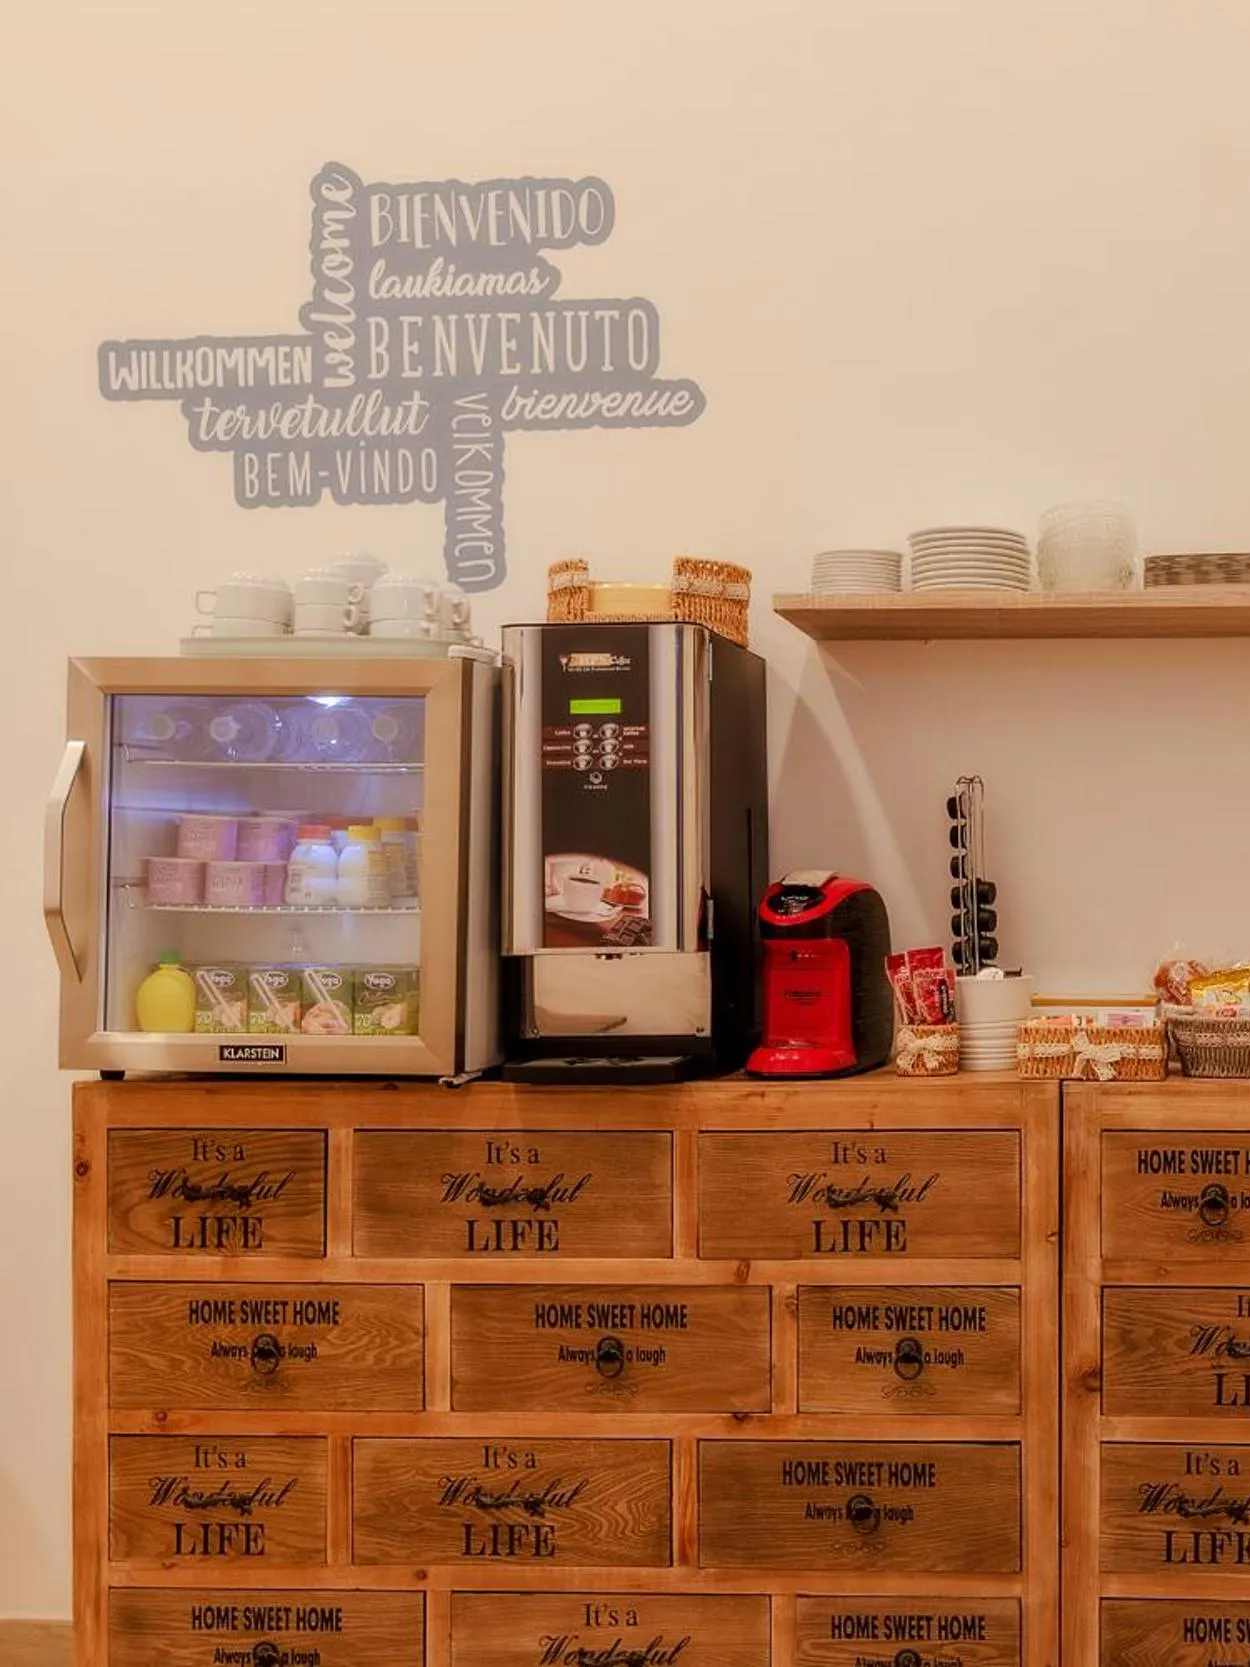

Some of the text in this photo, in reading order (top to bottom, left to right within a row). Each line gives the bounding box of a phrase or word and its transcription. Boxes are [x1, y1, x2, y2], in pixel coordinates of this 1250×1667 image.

[369, 187, 605, 249] BIENVENIDO
[321, 172, 357, 388] welcome
[368, 256, 551, 300] laukiamas
[367, 308, 652, 380] BENVENUTO
[108, 345, 313, 391] WILLKOMMEN
[193, 389, 430, 442] tervetullut
[501, 386, 695, 420] bienvenue
[223, 1047, 280, 1059] KLARSTEIN
[192, 1138, 245, 1161] It's a
[486, 1141, 540, 1164] It's a
[832, 1141, 887, 1164] It's a
[1137, 1150, 1186, 1175] HOME
[1190, 1150, 1240, 1175] SWEET
[148, 1169, 296, 1204] Wodful
[440, 1172, 592, 1205] Wodful
[786, 1172, 941, 1205] Wodful
[1160, 1190, 1199, 1210] Always
[170, 1216, 263, 1249] LIFE
[466, 1220, 559, 1252] LIFE
[812, 1220, 907, 1253] LIFE
[189, 1301, 340, 1326] HOME SWEET HOME
[535, 1304, 688, 1329] HOME SWEET HOME
[832, 1306, 986, 1332] HOME SWEET HOME
[211, 1341, 249, 1362] Always
[288, 1341, 318, 1362] laugh
[557, 1345, 595, 1365] Always
[636, 1345, 667, 1366] laugh
[855, 1347, 893, 1368] Always
[934, 1347, 965, 1368] laugh
[194, 1446, 247, 1469] It's a
[483, 1446, 537, 1469] It's a
[1184, 1451, 1240, 1476] It's a
[782, 1462, 936, 1487] HOME SWEET HOME
[148, 1475, 298, 1509] Wodful
[436, 1475, 590, 1510] Wodful
[804, 1502, 844, 1523] Always
[884, 1503, 915, 1524] laugh
[173, 1523, 265, 1556] LIFE
[461, 1523, 556, 1557] LIFE
[192, 1606, 342, 1632] HOME SWEET HOME
[585, 1604, 638, 1627] It's a
[831, 1615, 986, 1640] HOME SWEET HOME
[1184, 1619, 1231, 1644] HOME
[214, 1647, 251, 1667] Always
[291, 1647, 321, 1667] laugh
[539, 1635, 691, 1667] Wodful
